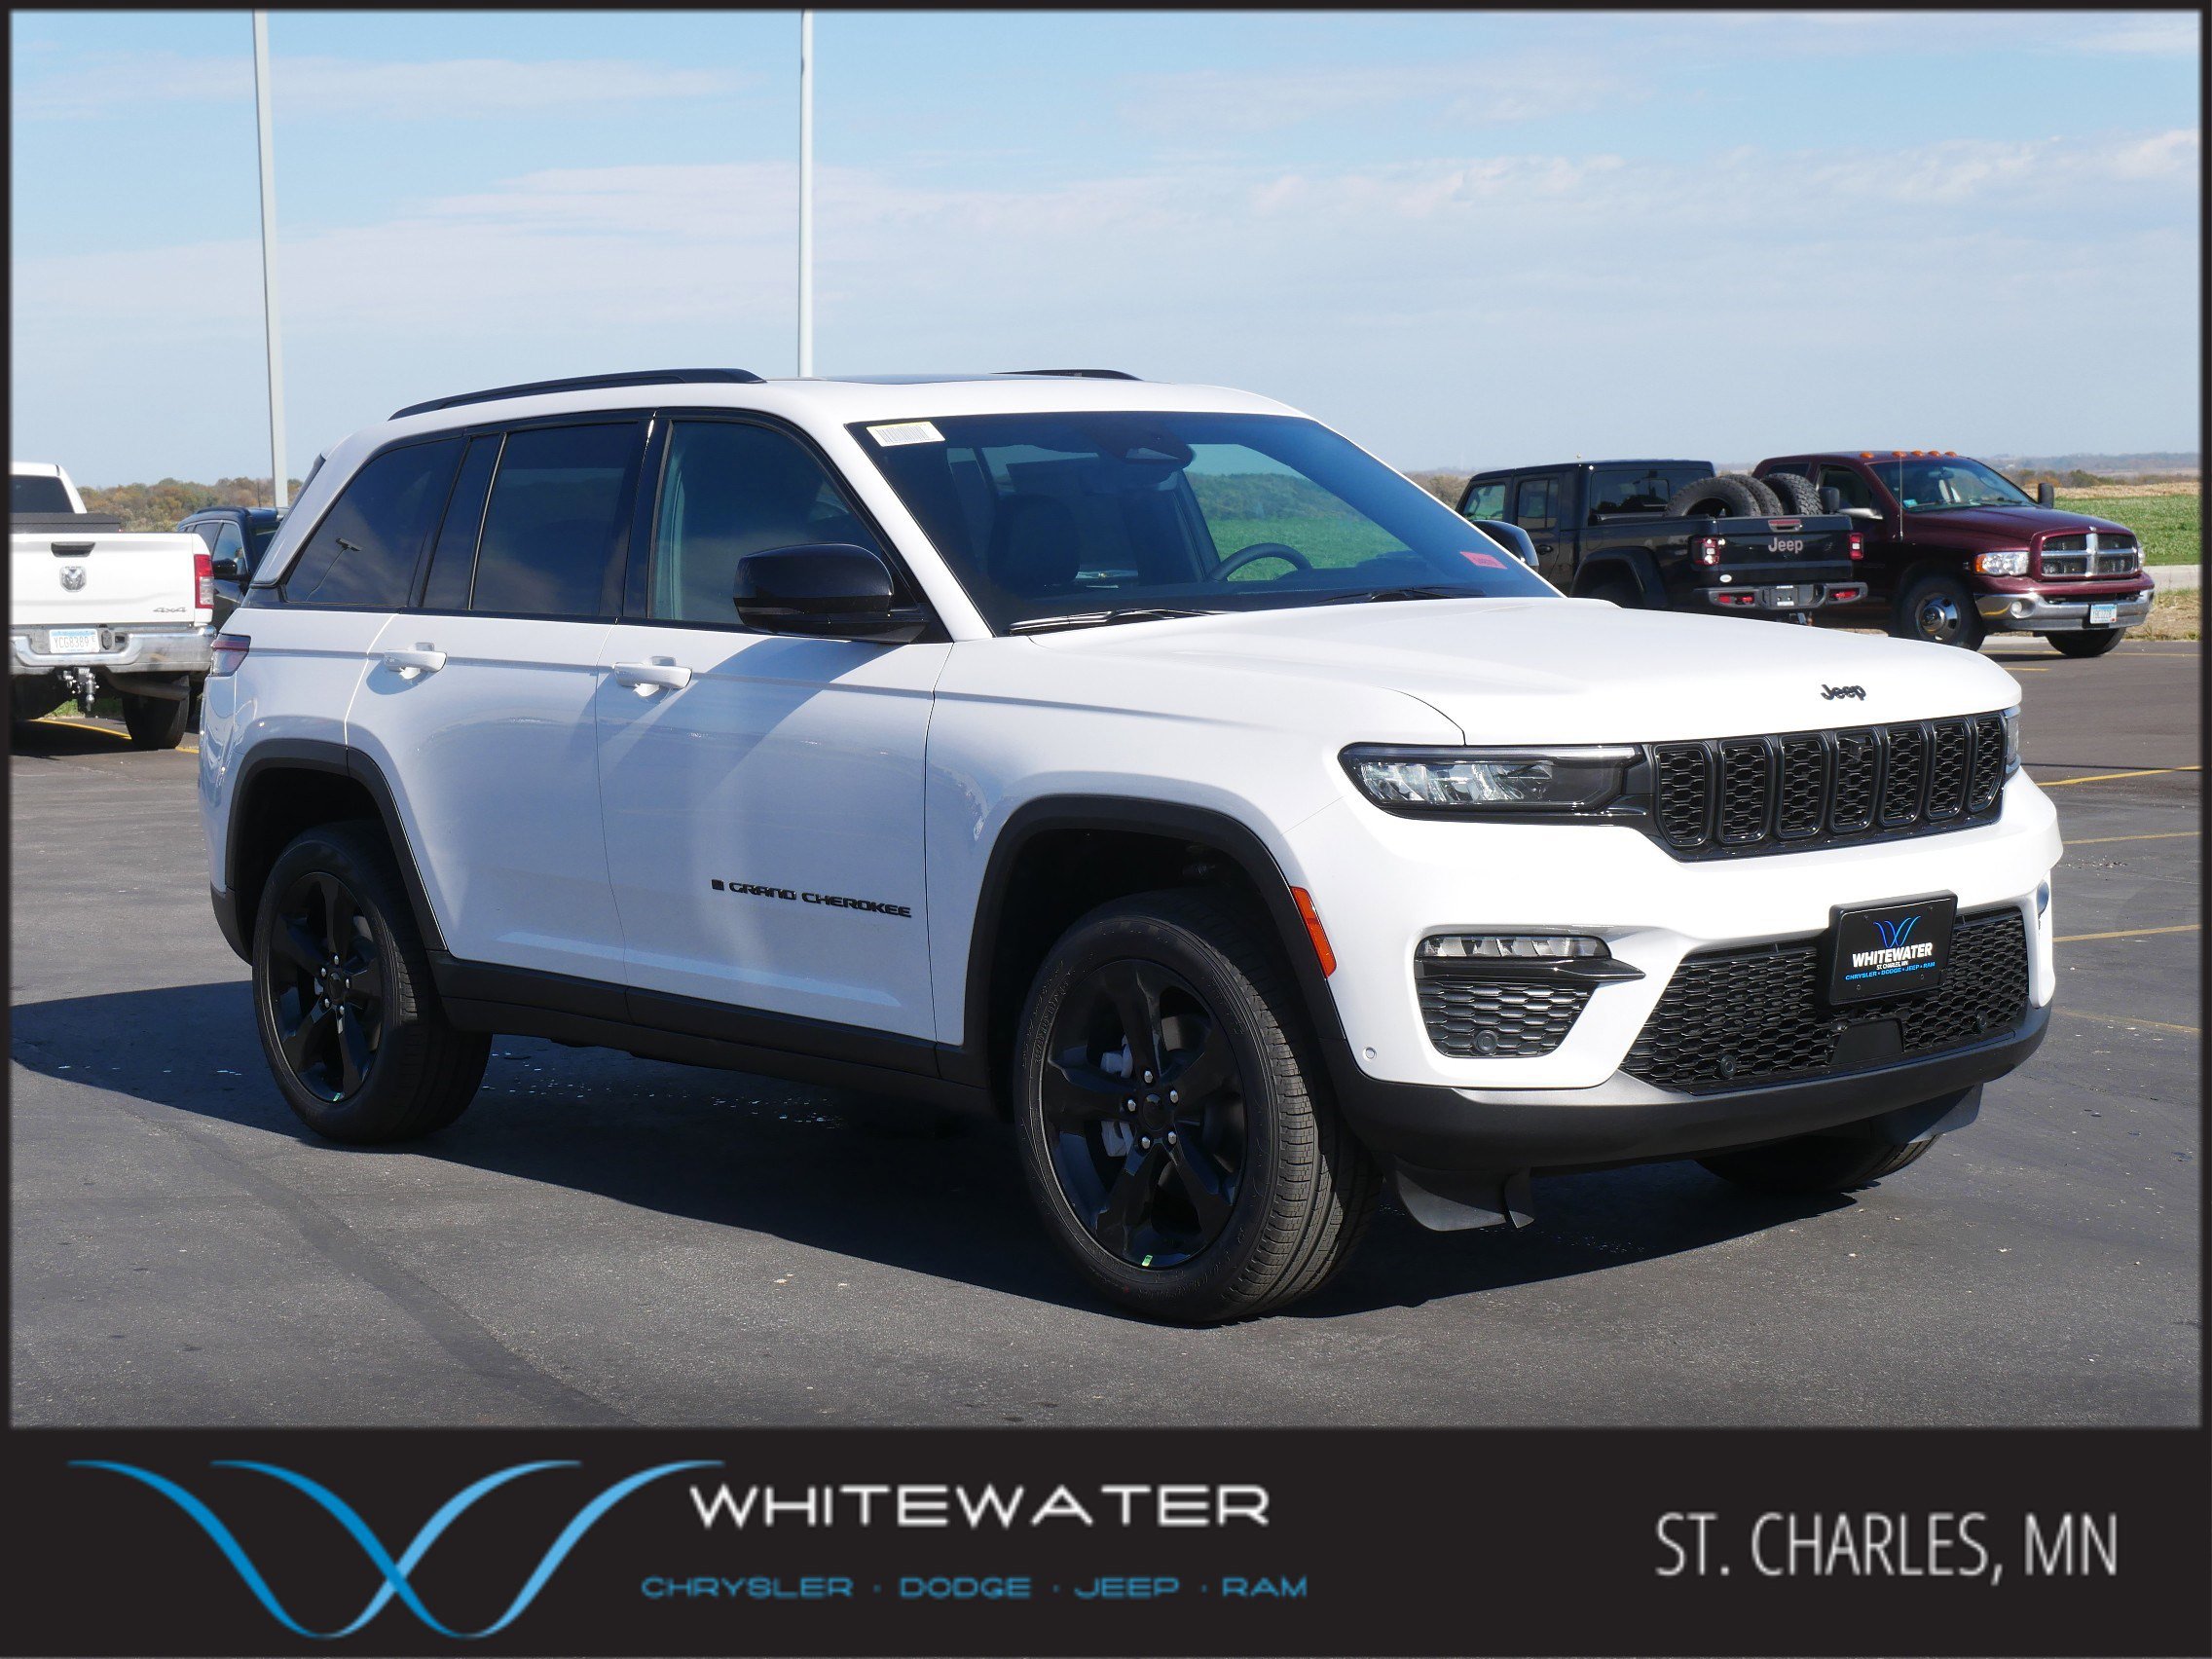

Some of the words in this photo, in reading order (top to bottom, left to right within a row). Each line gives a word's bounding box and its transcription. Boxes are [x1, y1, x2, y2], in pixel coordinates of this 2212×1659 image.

[1768, 537, 1803, 554] Jeep
[1820, 684, 1866, 701] Jeep
[729, 881, 797, 901] GRAND
[801, 892, 912, 918] CHEROKEE
[1852, 941, 1933, 968] WHITEWATER
[1845, 971, 1877, 980] CHRYSLER
[1881, 967, 1901, 976] DODGE
